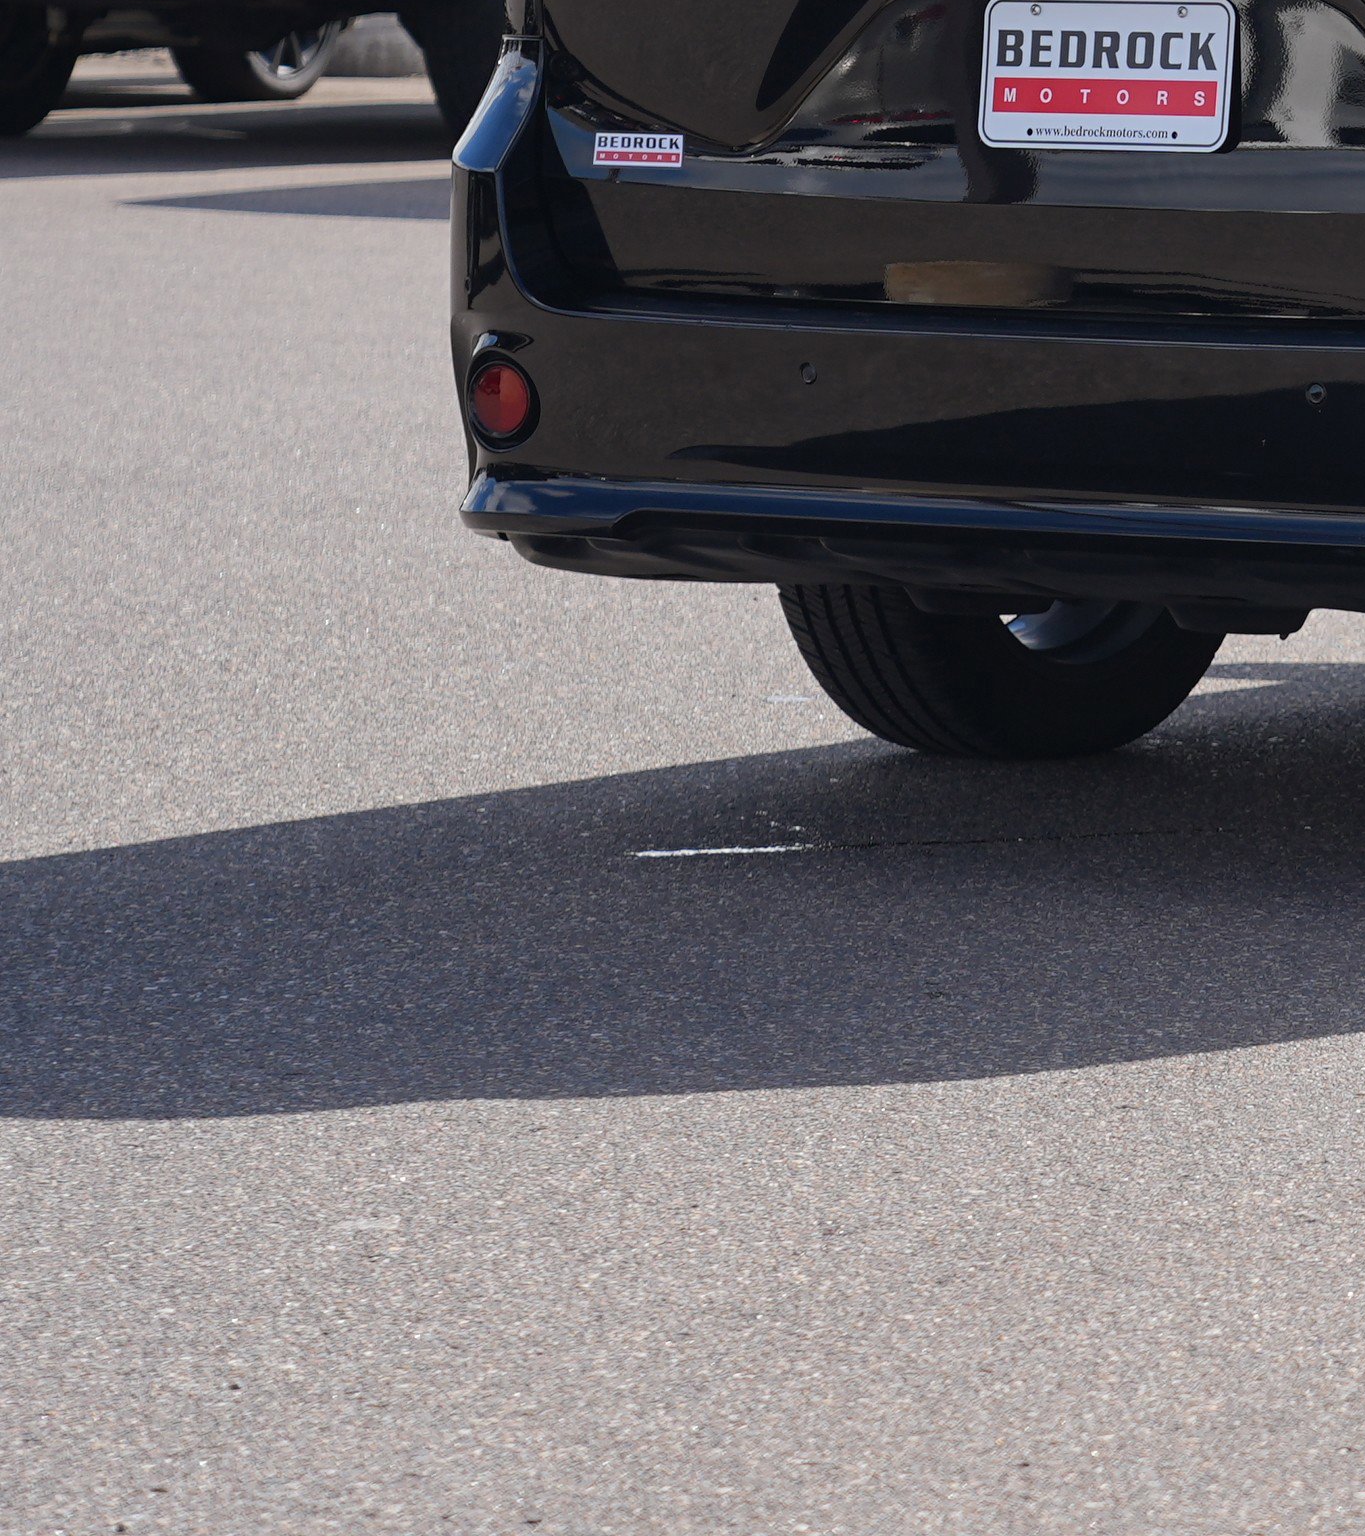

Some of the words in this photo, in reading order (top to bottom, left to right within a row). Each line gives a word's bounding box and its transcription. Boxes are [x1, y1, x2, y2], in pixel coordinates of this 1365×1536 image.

[996, 29, 1217, 71] BEDROCK
[1004, 87, 1206, 107] MOTORS
[1035, 125, 1169, 140] www.bedrockmotors.com
[597, 136, 680, 150] BEDROCK
[599, 153, 677, 162] MOTORS
